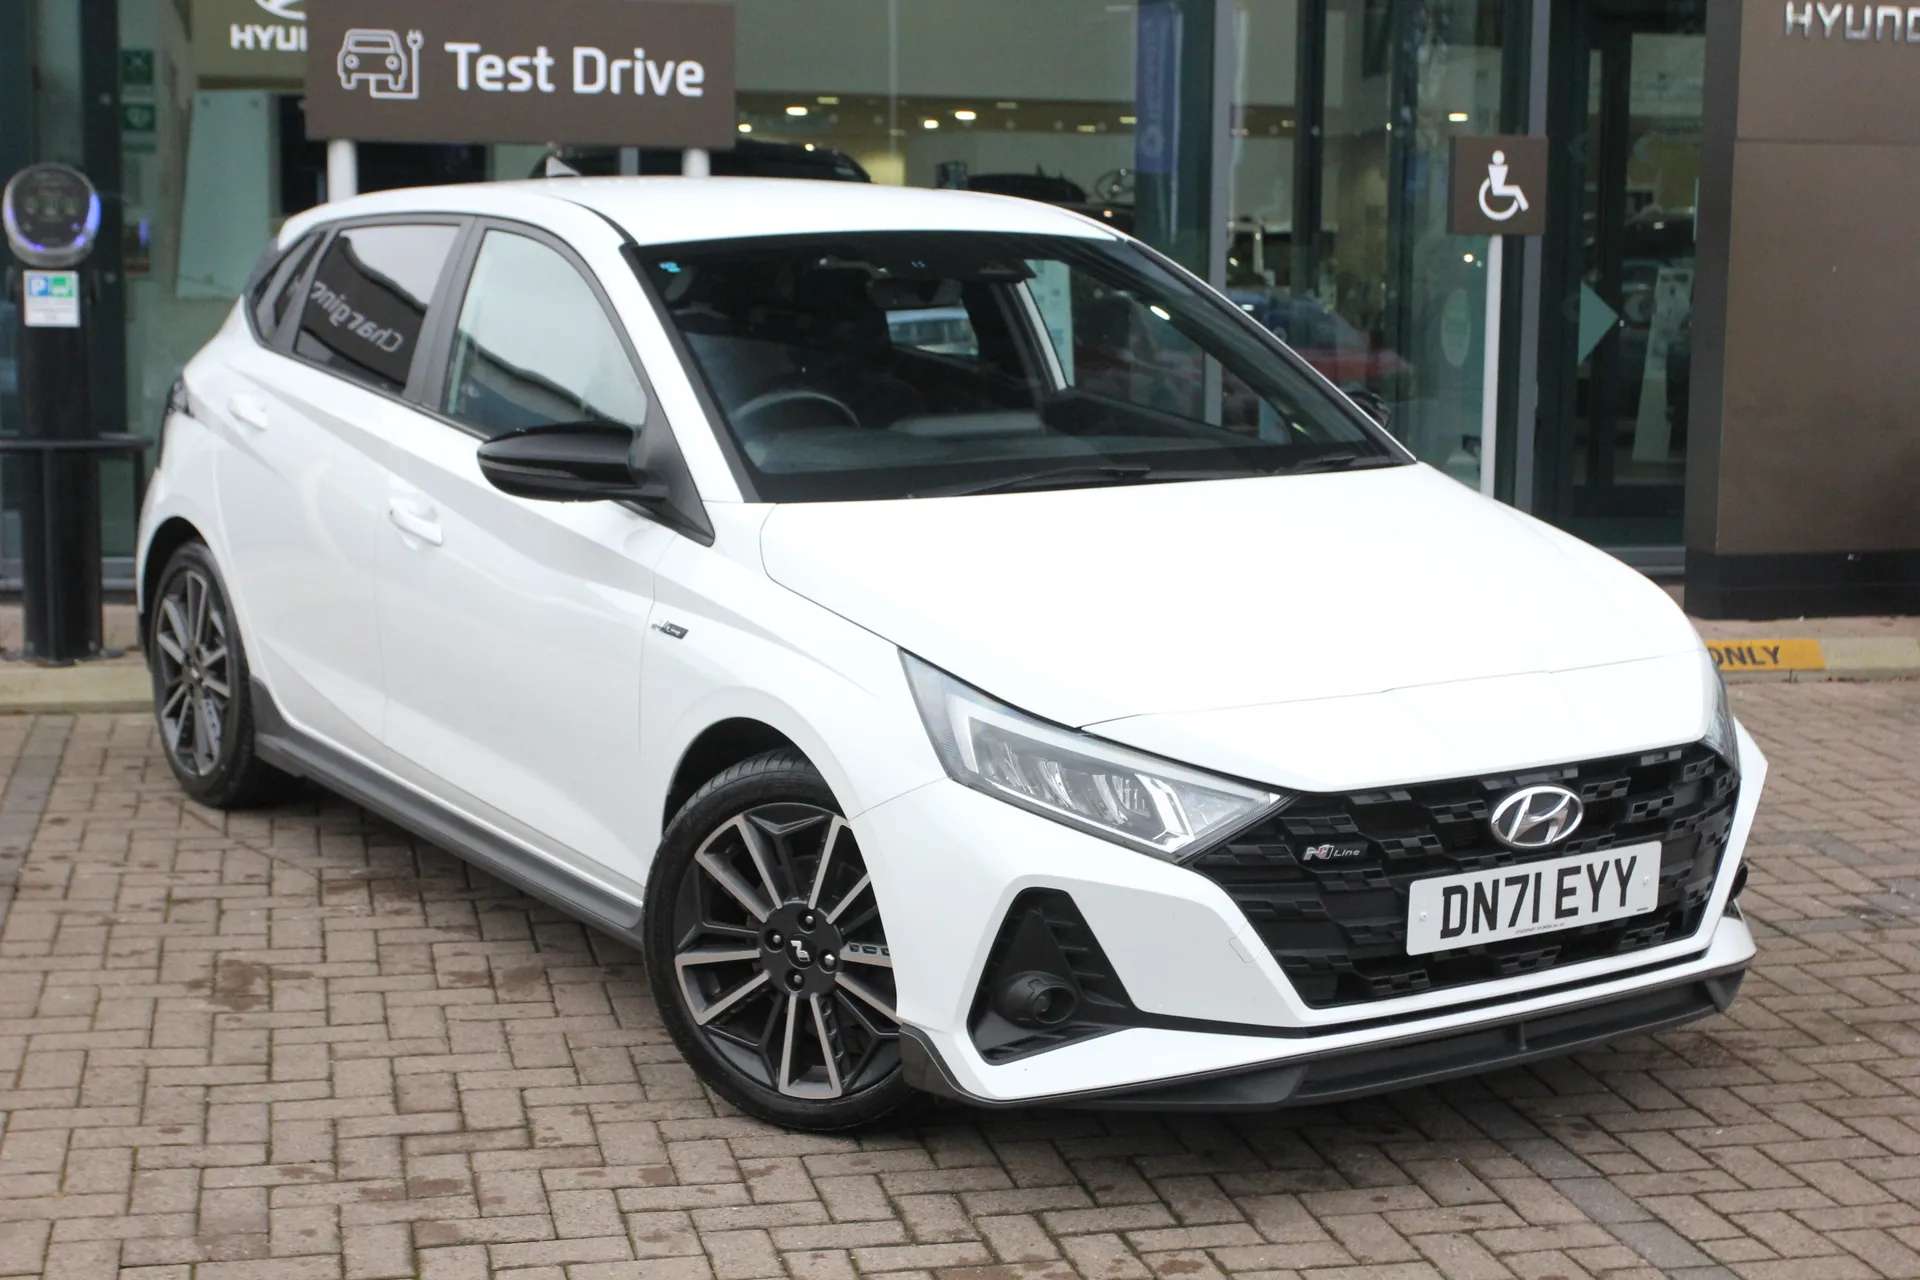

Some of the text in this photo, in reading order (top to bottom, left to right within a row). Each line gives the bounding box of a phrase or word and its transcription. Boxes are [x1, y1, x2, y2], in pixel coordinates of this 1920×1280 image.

[444, 42, 704, 97] Test Drive
[1707, 645, 1780, 666] ONLY
[1440, 856, 1637, 939] DN71 EYY
